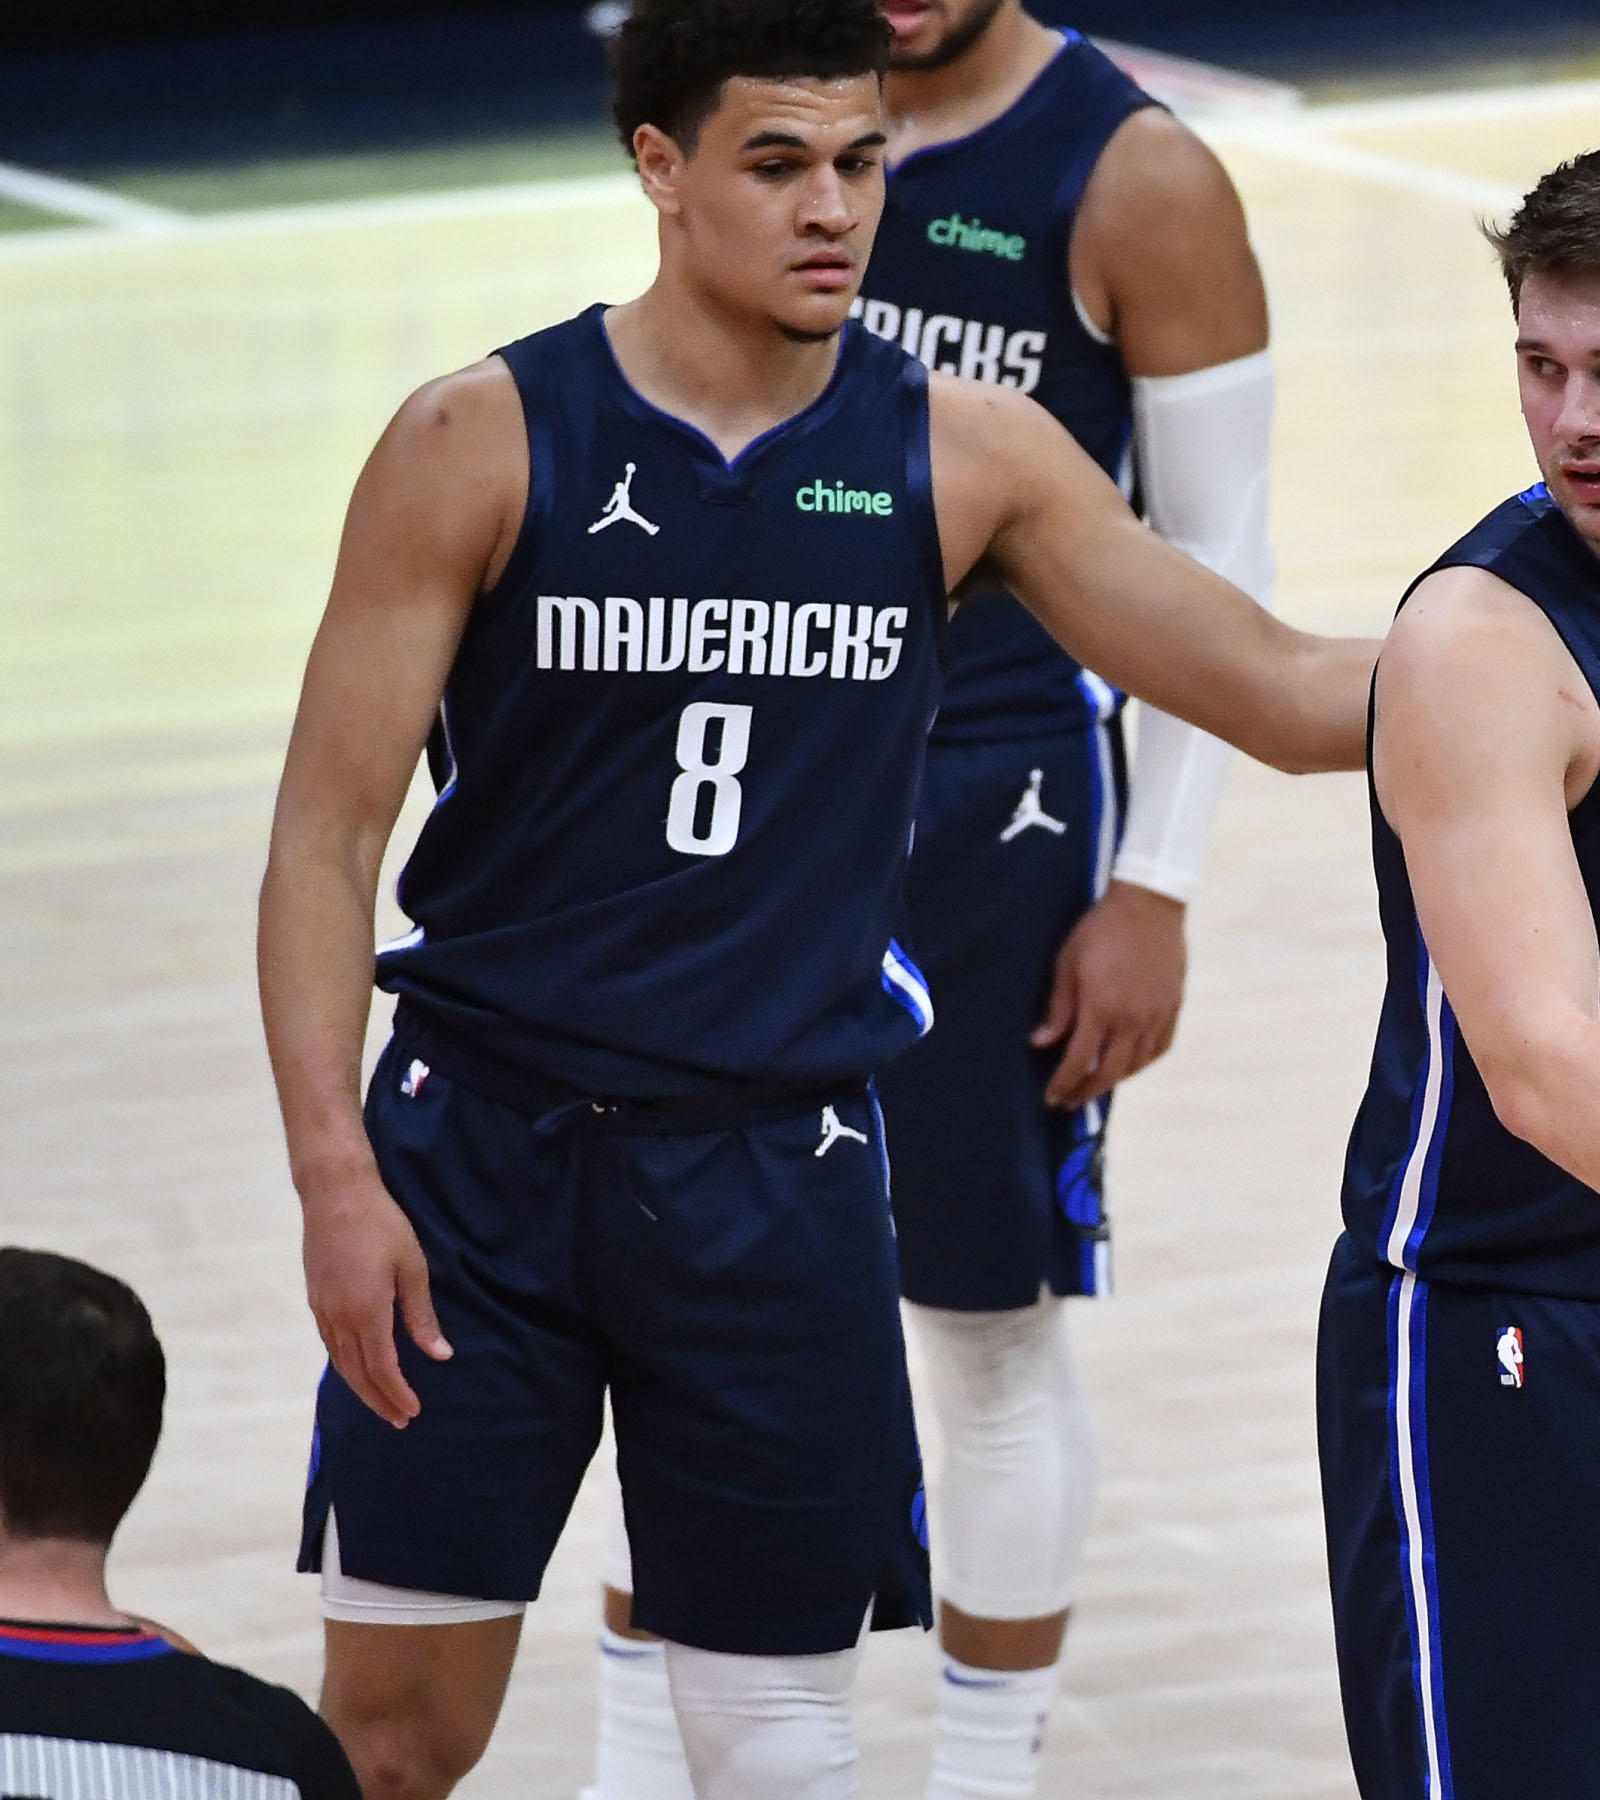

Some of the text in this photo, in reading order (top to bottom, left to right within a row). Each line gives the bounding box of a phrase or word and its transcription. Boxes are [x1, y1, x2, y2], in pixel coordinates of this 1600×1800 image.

[927, 213, 1026, 261] chime
[849, 296, 1047, 395] RICKS
[796, 479, 893, 517] chime
[536, 595, 909, 681] MAVERICKS
[665, 701, 754, 857] 8
